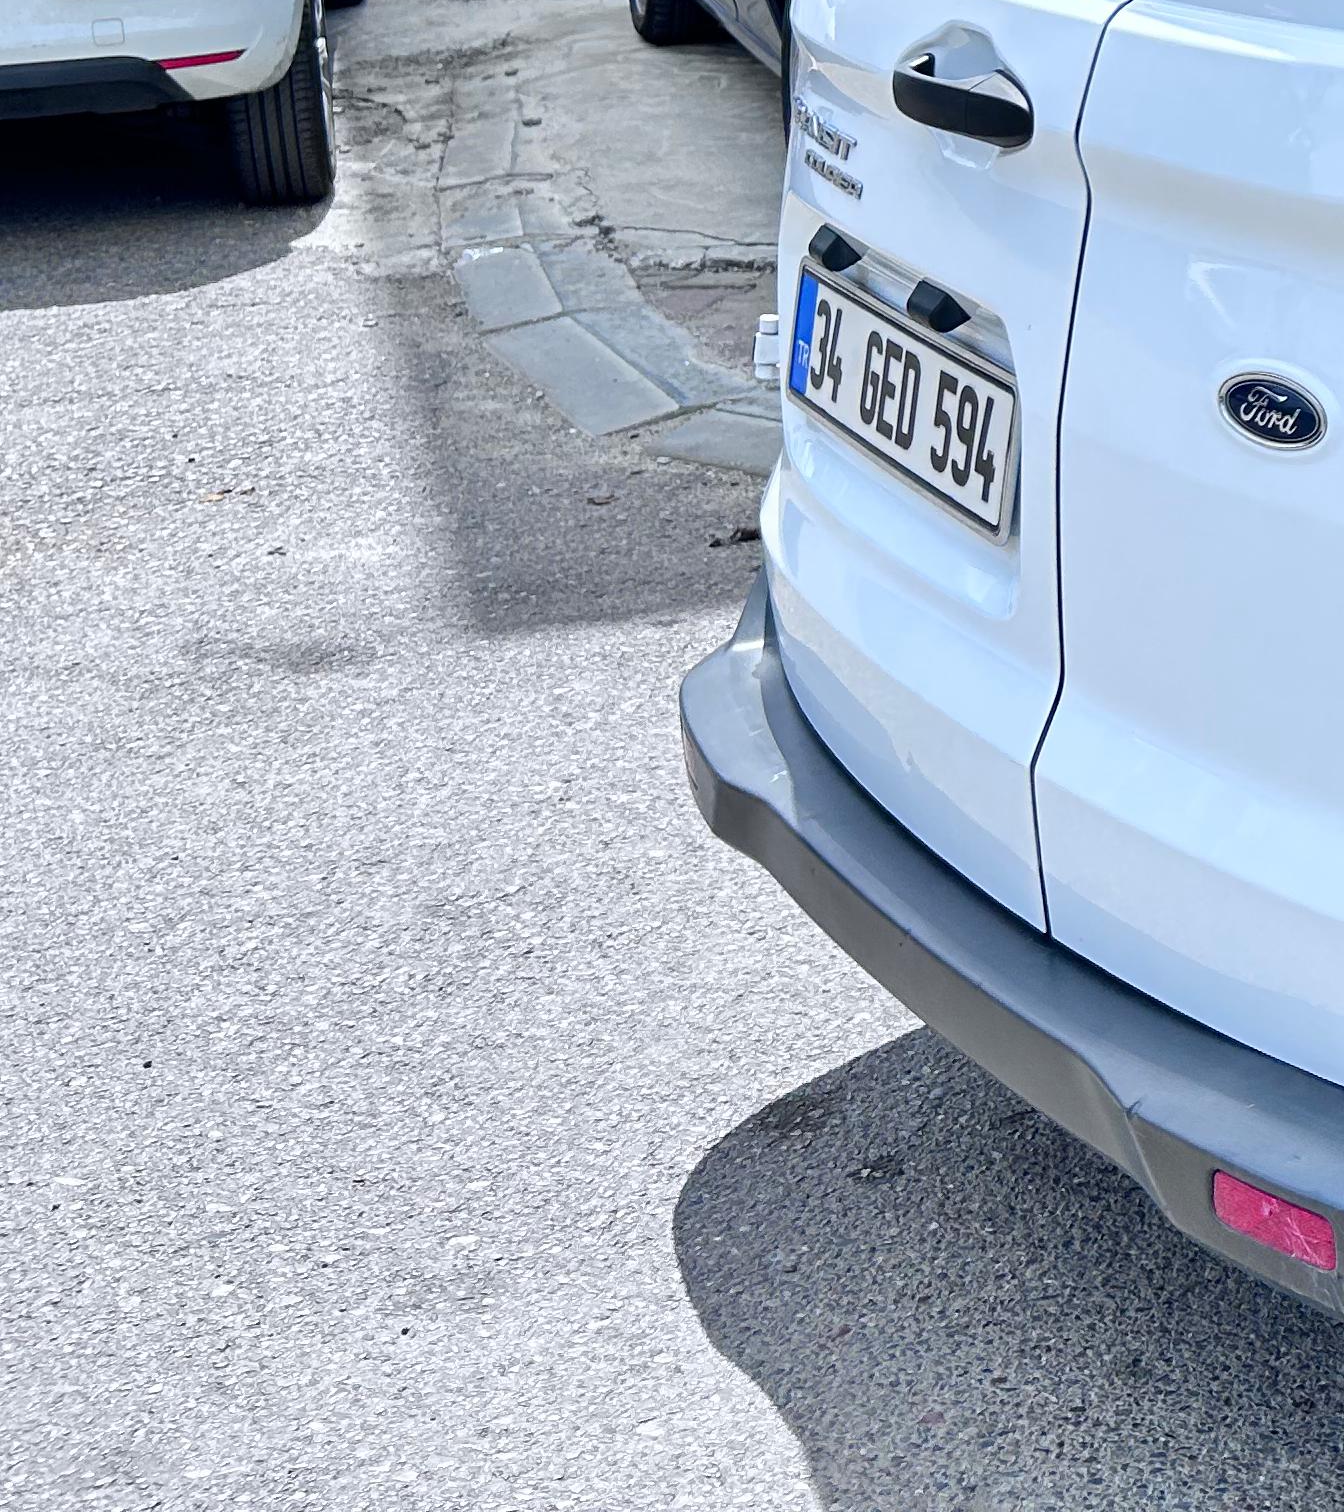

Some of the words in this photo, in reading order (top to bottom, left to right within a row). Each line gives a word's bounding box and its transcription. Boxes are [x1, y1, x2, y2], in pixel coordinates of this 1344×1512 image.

[797, 340, 810, 369] TR
[810, 299, 843, 403] 34
[860, 330, 922, 450] GED
[930, 370, 996, 503] 594
[1240, 386, 1301, 434] Ford
